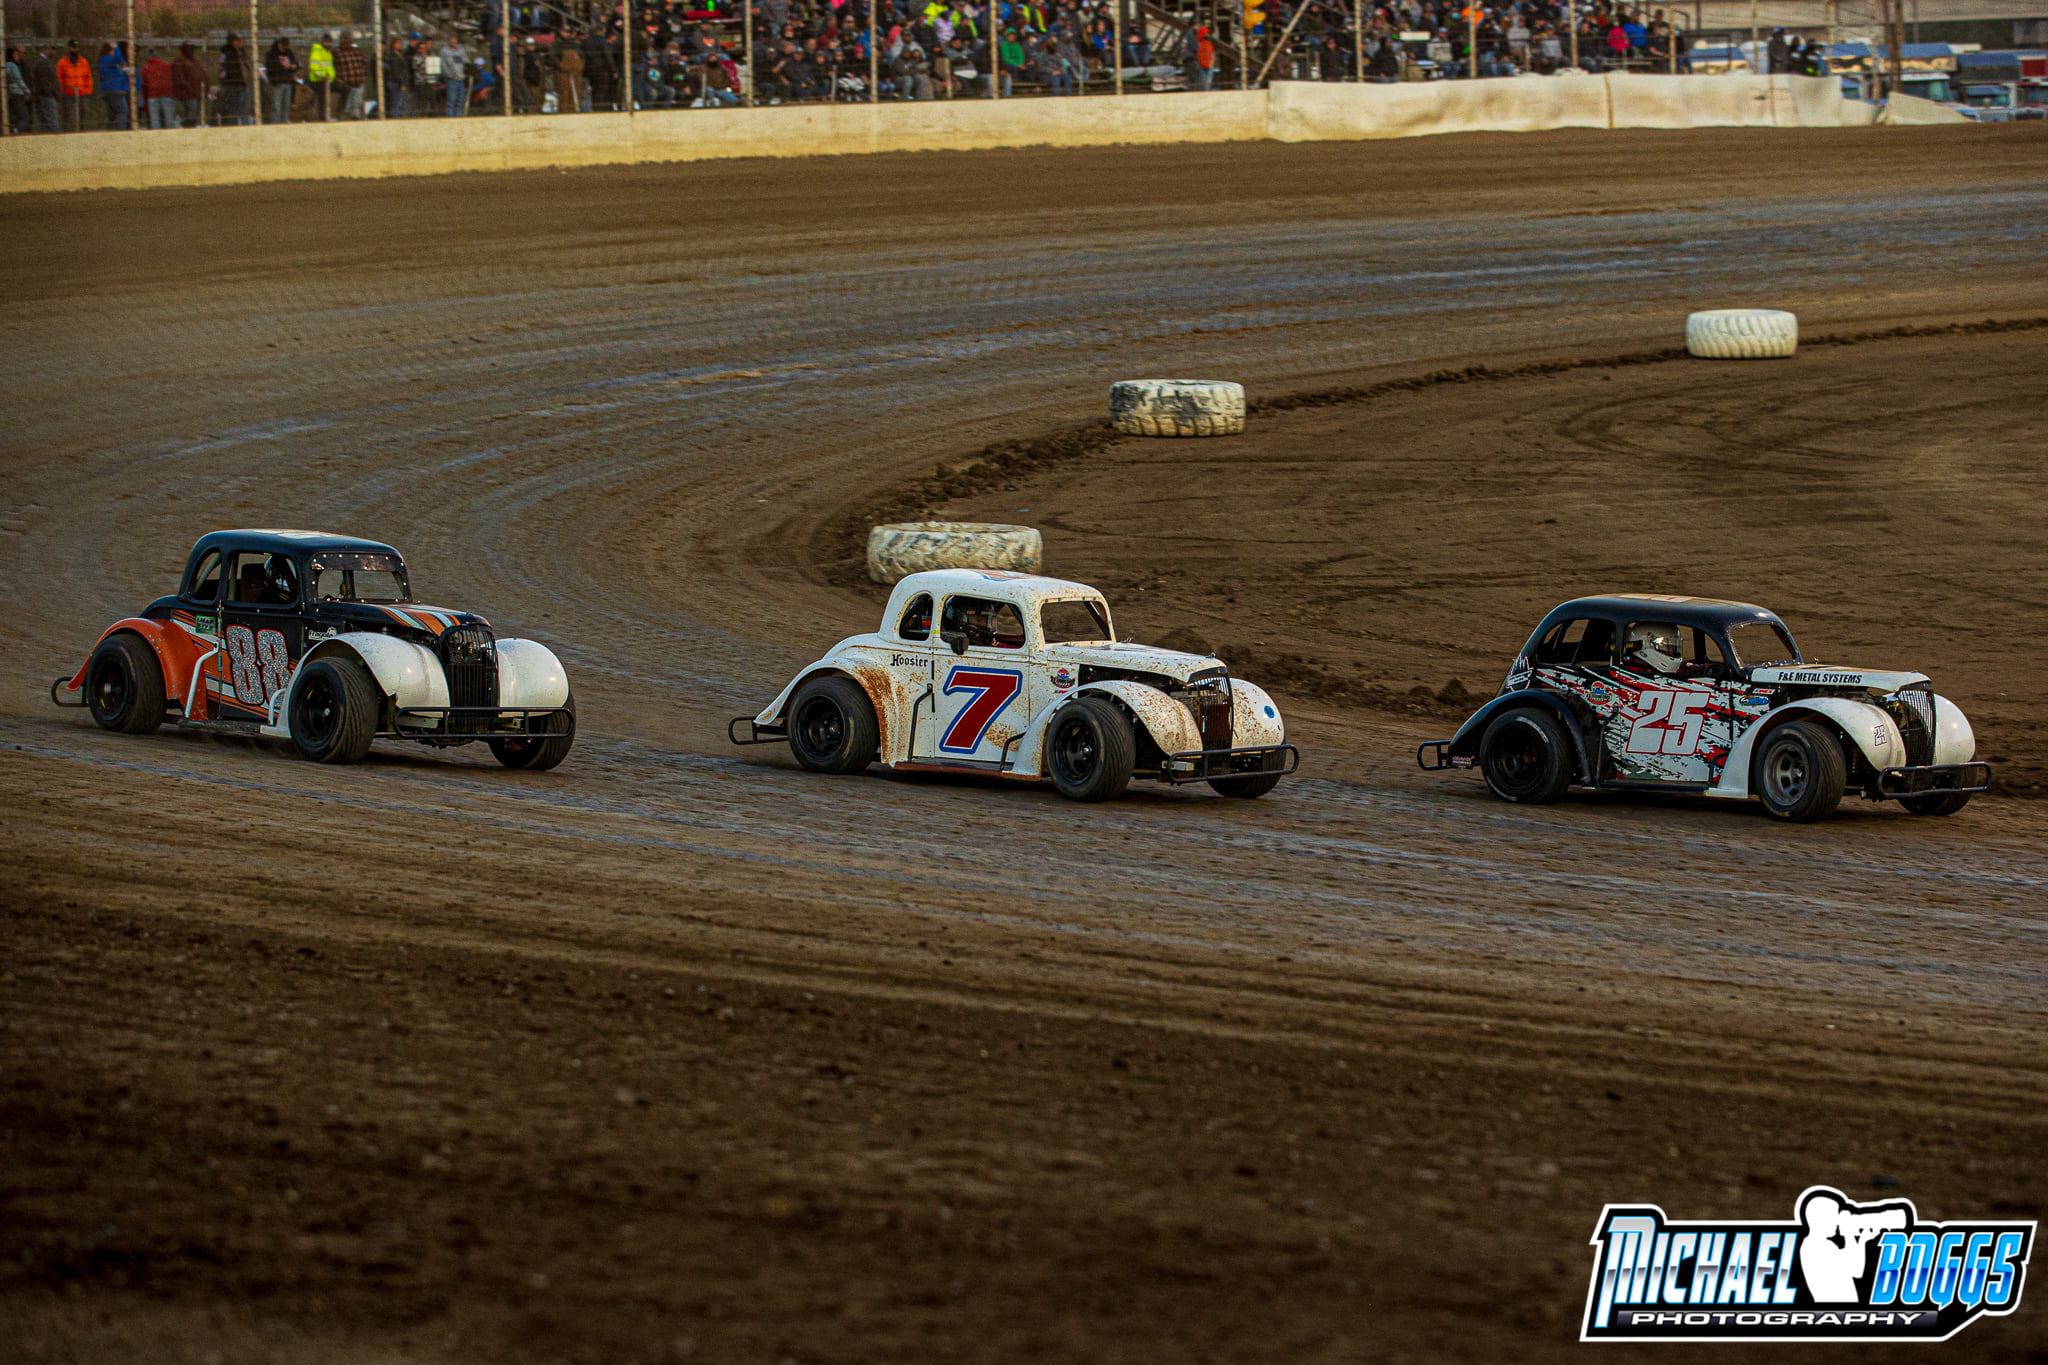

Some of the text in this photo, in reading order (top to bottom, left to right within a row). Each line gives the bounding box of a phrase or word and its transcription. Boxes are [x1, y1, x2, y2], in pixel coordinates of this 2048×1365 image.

[225, 624, 292, 707] 88
[890, 654, 928, 667] Hoosier
[1778, 671, 1862, 684] F&E METAL SYSTEMS
[939, 665, 1023, 754] 7
[1625, 690, 1711, 756] 25
[1873, 725, 1887, 746] 25
